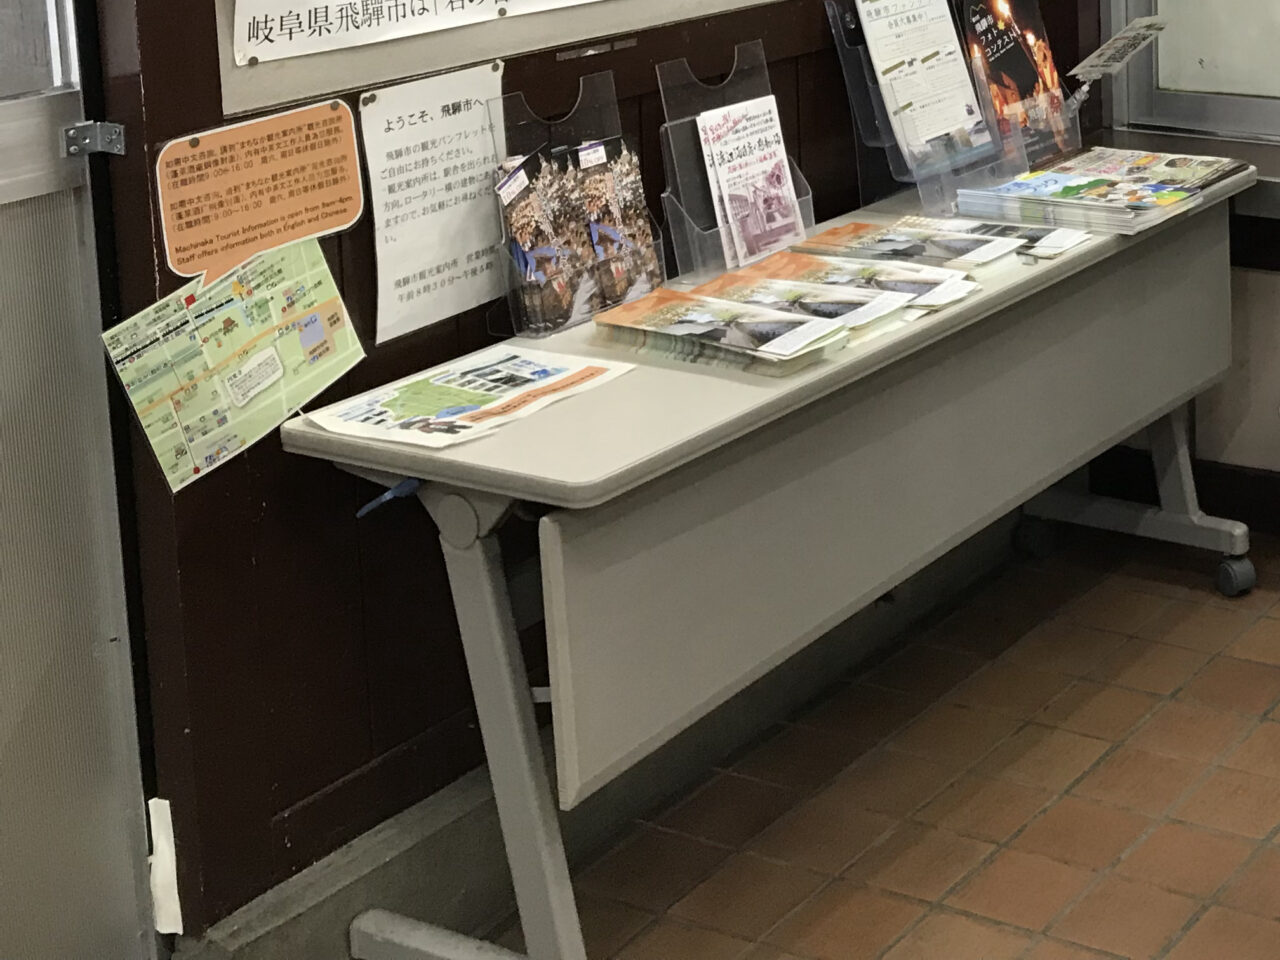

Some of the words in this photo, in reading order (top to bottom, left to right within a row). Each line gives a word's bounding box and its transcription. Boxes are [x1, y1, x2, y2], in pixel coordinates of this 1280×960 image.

[216, 230, 240, 241] Tourist
[242, 218, 279, 233] Information
[177, 255, 195, 265] Staff
[197, 248, 218, 259] offers
[220, 235, 258, 251] information
[259, 229, 275, 240] both
